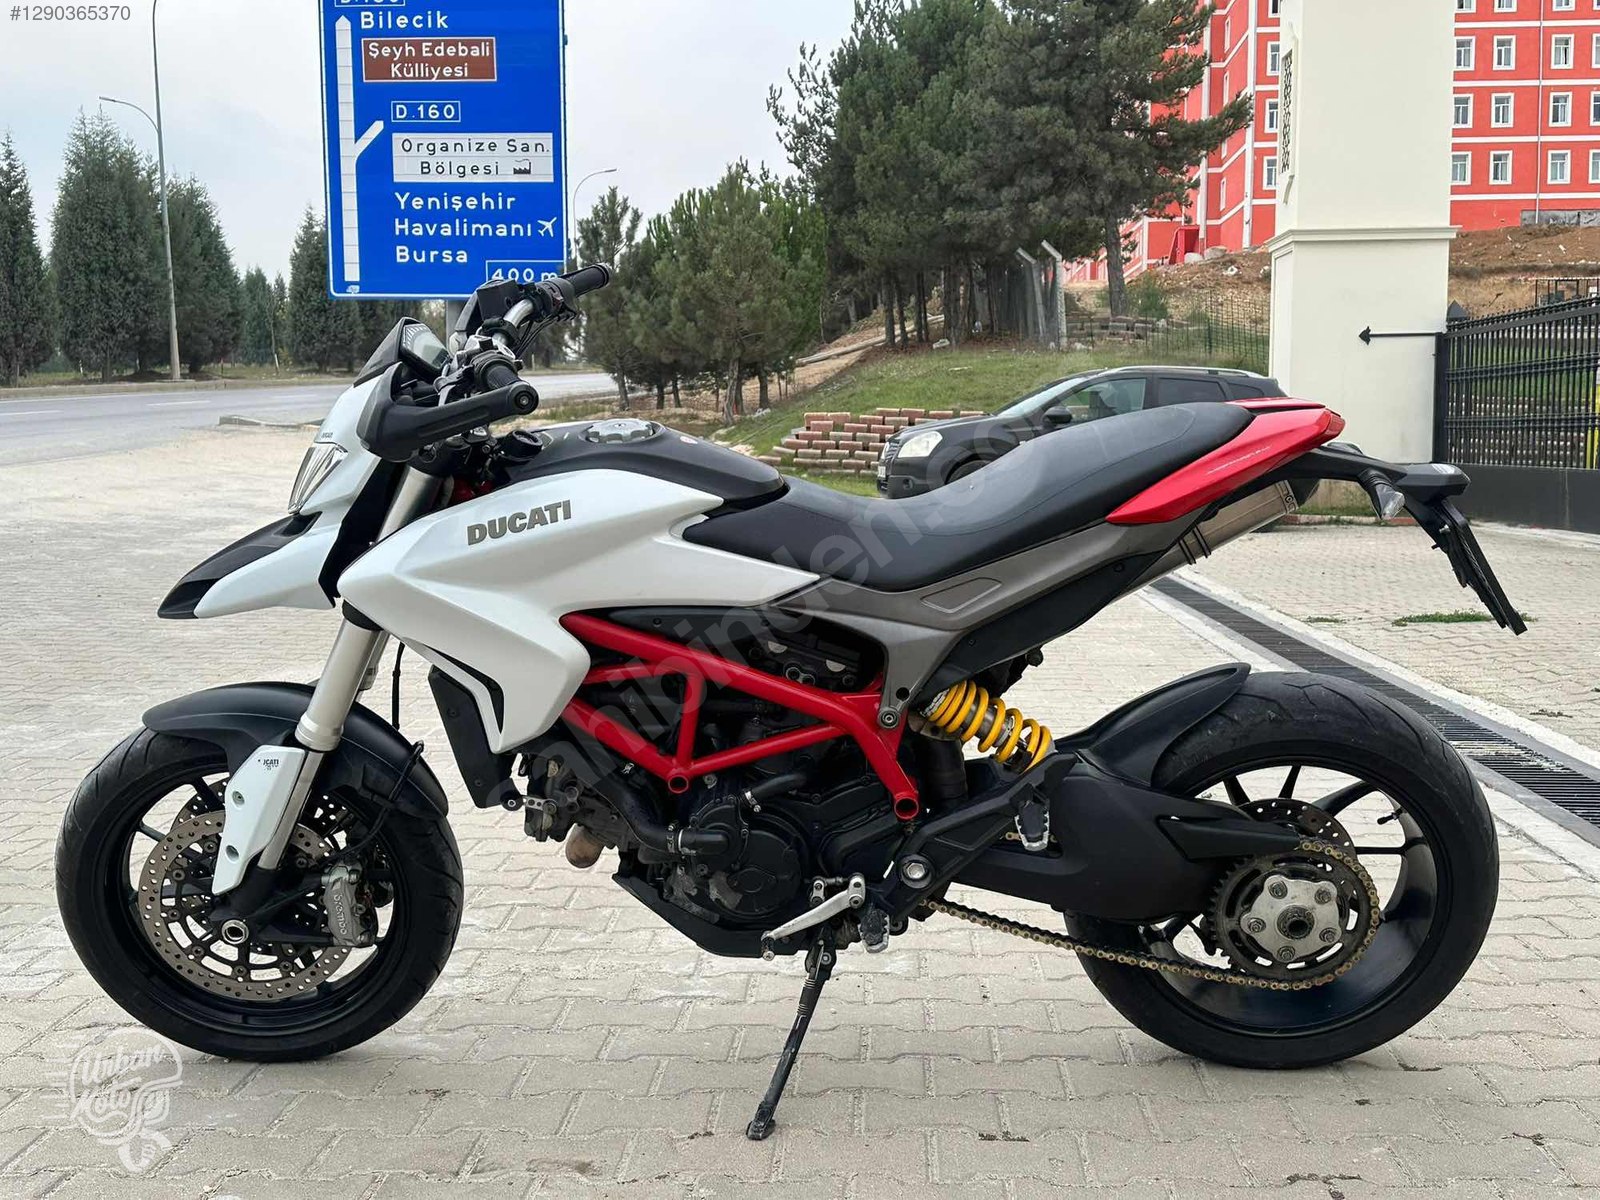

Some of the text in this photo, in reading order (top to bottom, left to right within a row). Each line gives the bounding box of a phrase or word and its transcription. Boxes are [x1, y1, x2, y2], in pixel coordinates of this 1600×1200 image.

[360, 10, 449, 29] Bilecik
[368, 42, 490, 61] Şeyh Edebali
[391, 63, 468, 81] Külliyesi
[401, 138, 550, 156] Organize San.
[420, 161, 499, 177] Bölgesi
[394, 192, 516, 212] Yenişehir
[394, 218, 532, 236] Havalimanı
[395, 245, 468, 263] Bursa
[491, 267, 558, 282] 400 m
[467, 499, 572, 546] DUCATI
